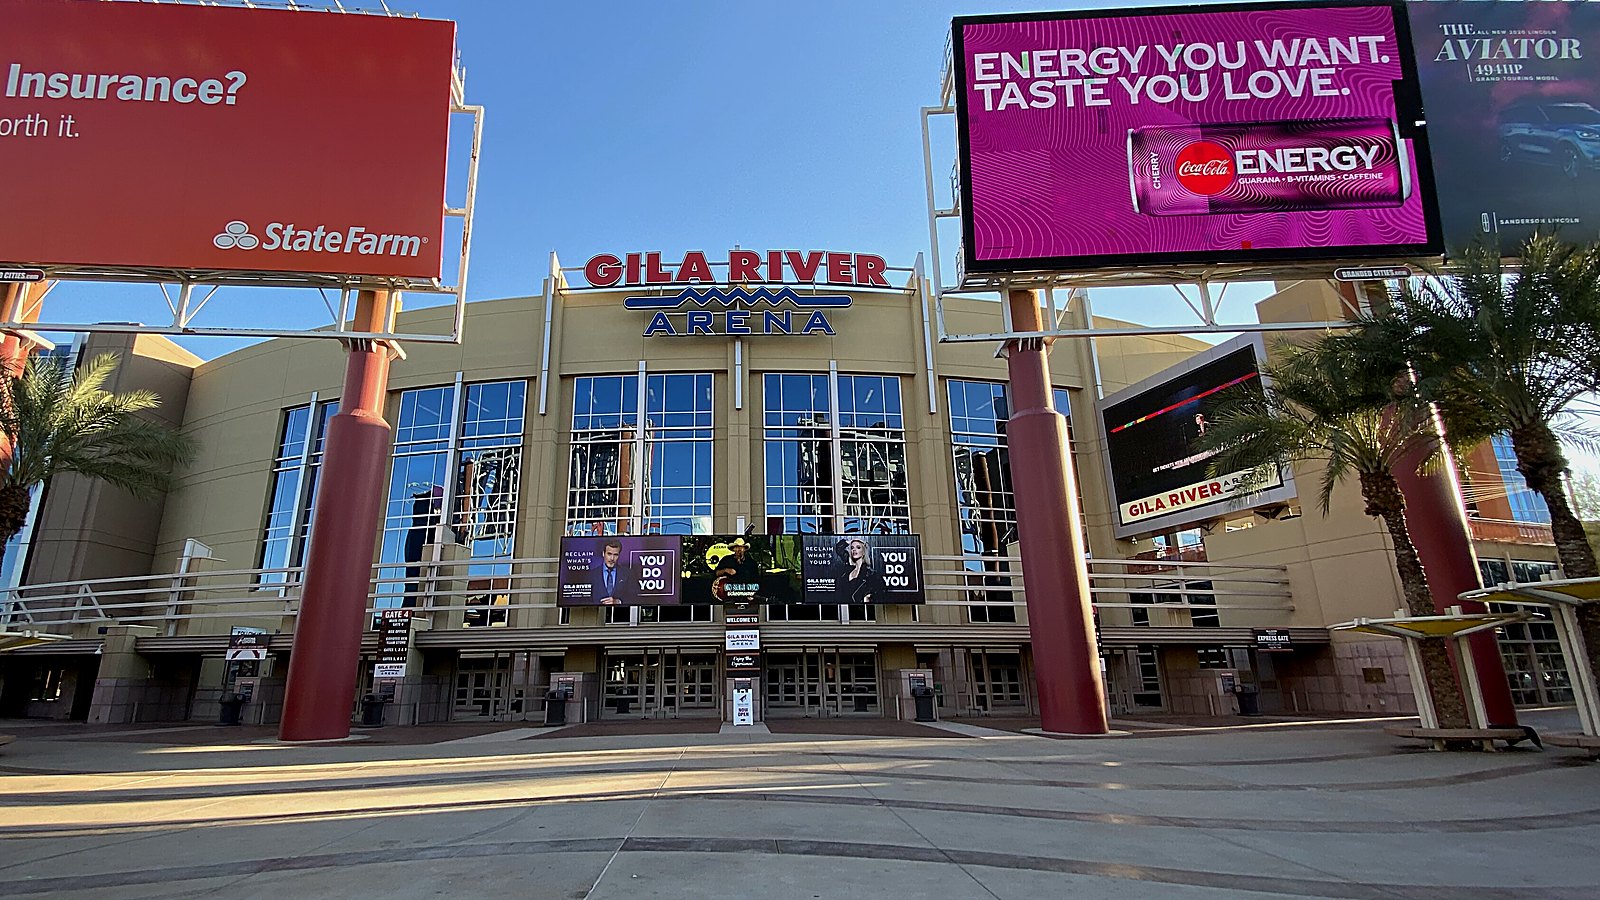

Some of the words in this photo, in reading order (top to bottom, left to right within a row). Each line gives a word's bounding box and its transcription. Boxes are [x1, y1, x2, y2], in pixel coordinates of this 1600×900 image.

[1439, 23, 1475, 36] THE
[973, 46, 1147, 81] ENERGY
[1154, 40, 1247, 72] YOU
[1249, 35, 1390, 68] WANT.
[1433, 38, 1583, 61] AVIATOR
[1474, 64, 1524, 76] 494HP
[5, 63, 248, 106] Insurance?
[973, 77, 1111, 112] TASTE
[1117, 73, 1216, 105] YOU
[1222, 68, 1350, 101] LOVE.
[58, 114, 80, 137] it.
[1178, 159, 1231, 177] Coca-Cola
[1235, 144, 1380, 175] ENERGY
[1152, 151, 1162, 189] CHERRY
[1238, 176, 1281, 185] GUARANA
[1287, 173, 1336, 183] B-VITAMINS
[1342, 172, 1384, 181] CAFFEINE
[583, 250, 716, 288] GILA
[728, 249, 892, 288] RIVER
[642, 309, 837, 337] ARENA
[1128, 497, 1167, 517] GILA
[1168, 482, 1224, 508] RIVER
[639, 555, 666, 566] YOU
[881, 552, 907, 562] YOU
[642, 567, 662, 578] DO
[885, 564, 905, 574] DO
[638, 579, 665, 590] YOU
[882, 576, 909, 586] YOU
[385, 611, 403, 619] GATE
[403, 610, 409, 618] 4
